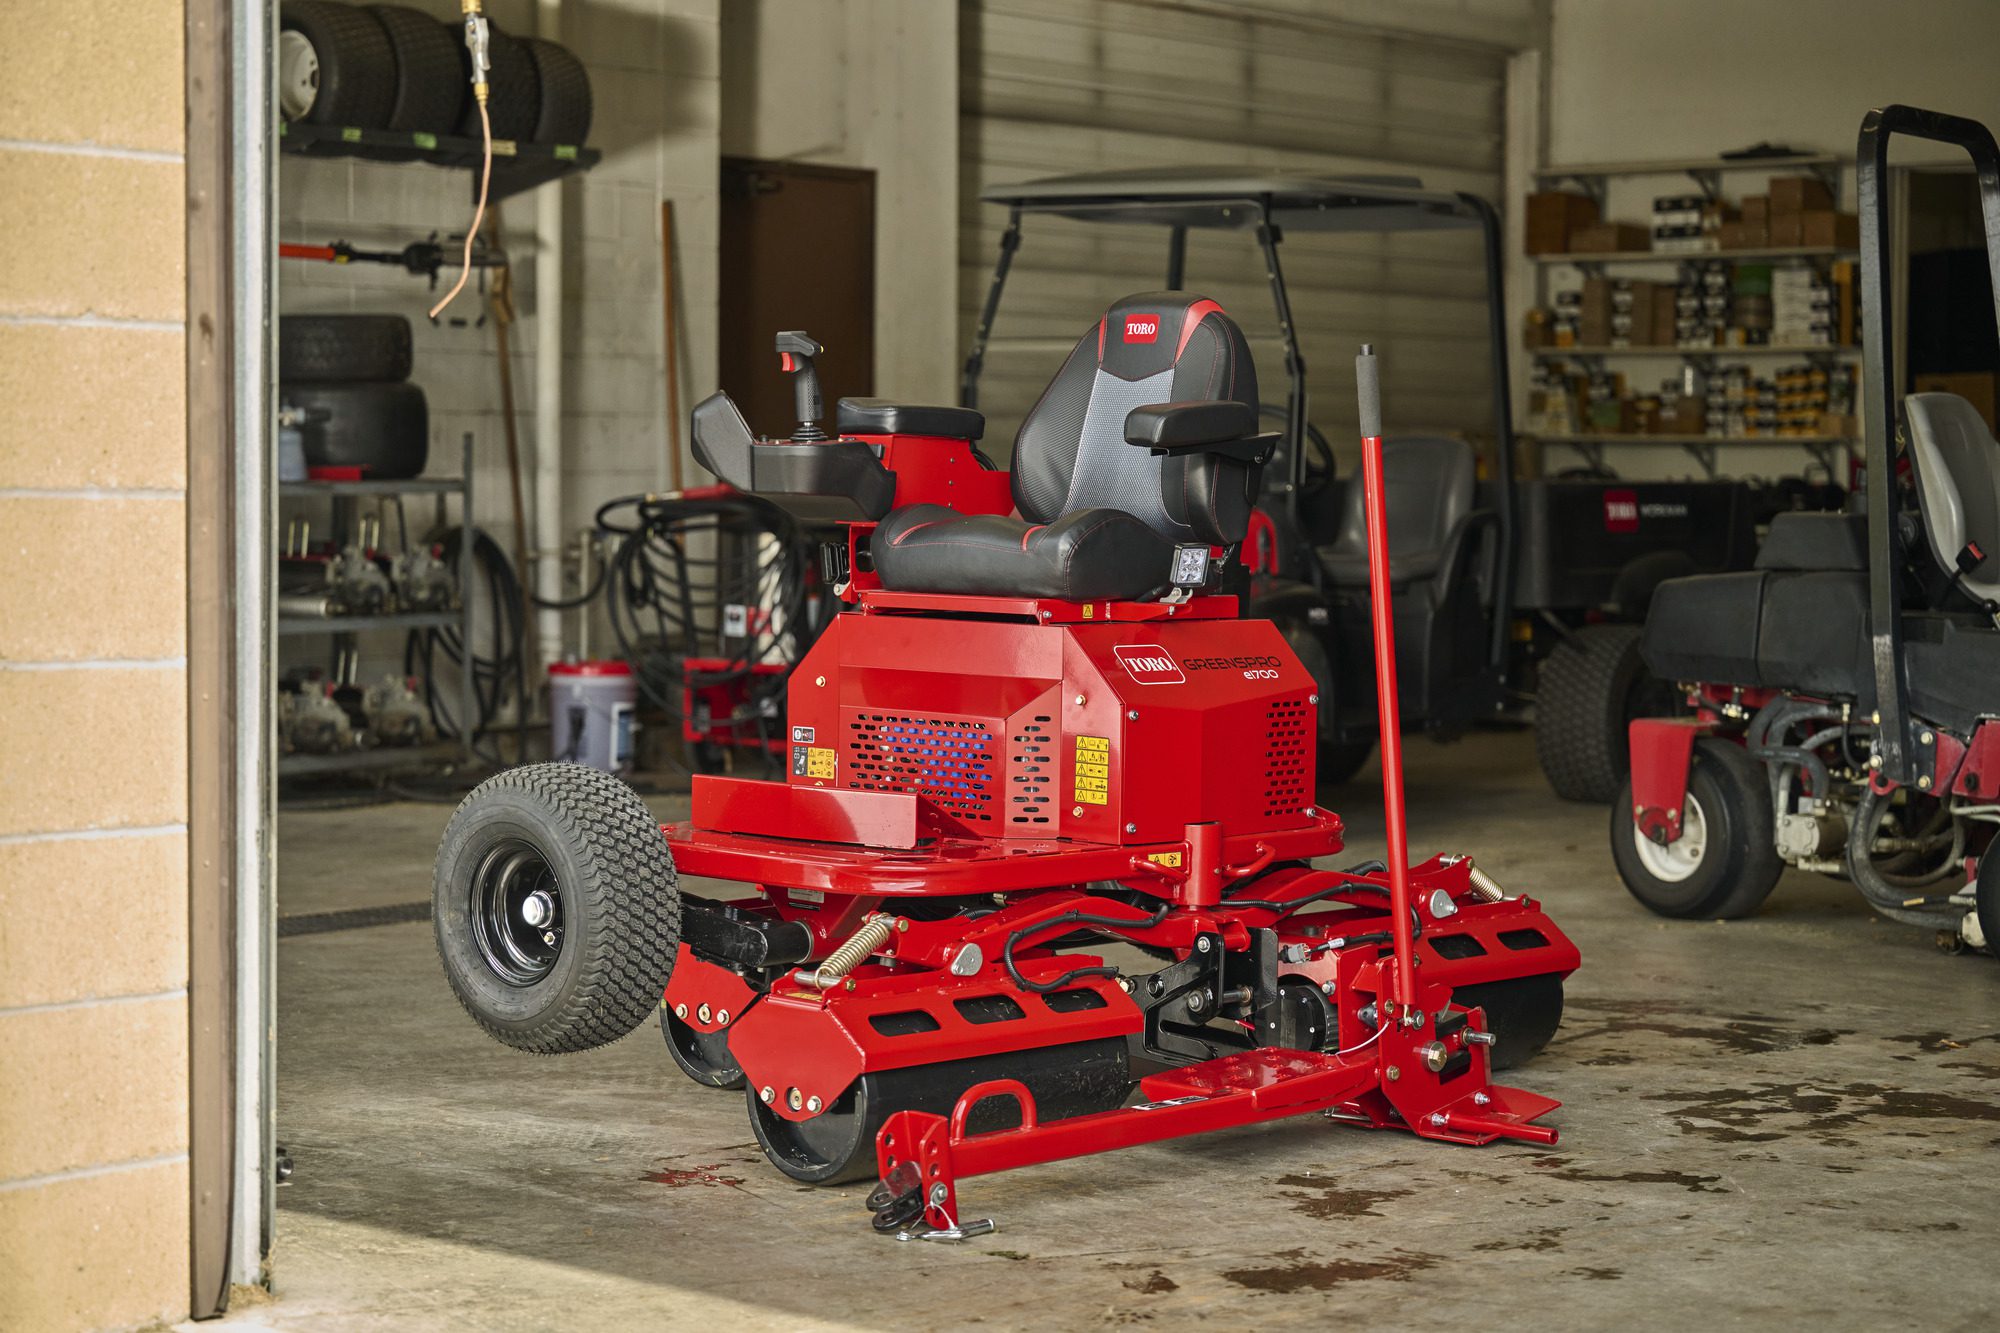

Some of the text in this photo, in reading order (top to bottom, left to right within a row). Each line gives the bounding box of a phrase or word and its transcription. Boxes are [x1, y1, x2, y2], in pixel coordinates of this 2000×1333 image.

[1127, 323, 1156, 335] TORO
[1124, 656, 1174, 672] TORO
[1183, 656, 1282, 670] GREENSPRO
